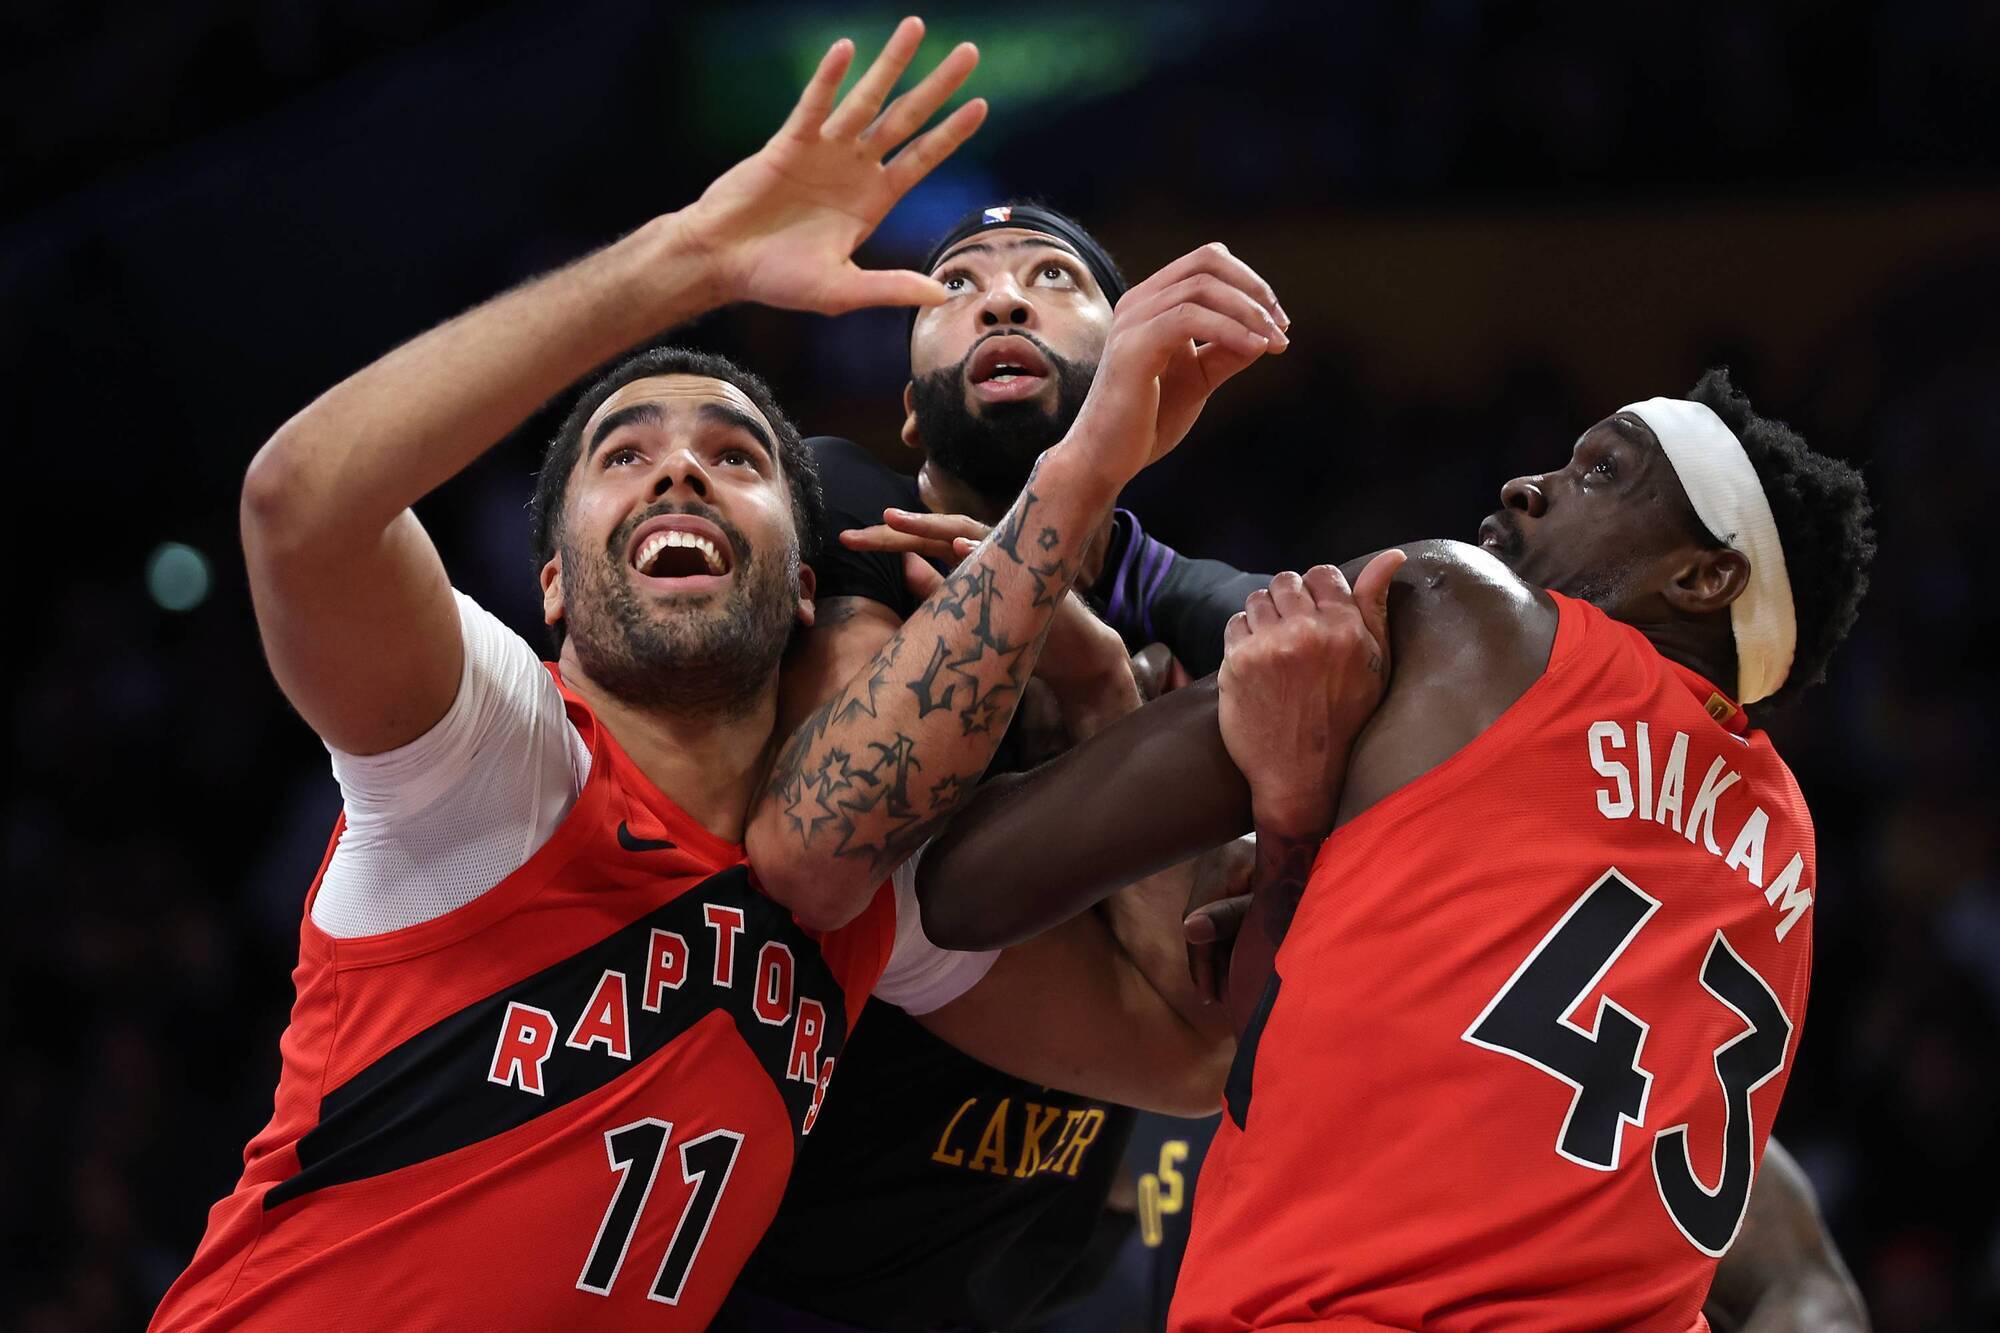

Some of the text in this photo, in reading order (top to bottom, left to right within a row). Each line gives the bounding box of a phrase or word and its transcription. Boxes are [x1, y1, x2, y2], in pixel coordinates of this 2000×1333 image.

[1587, 720, 1813, 944] SIAKAM
[487, 902, 835, 1136] RAPTORS
[1461, 866, 1793, 1259] 43
[575, 1117, 745, 1306] 11
